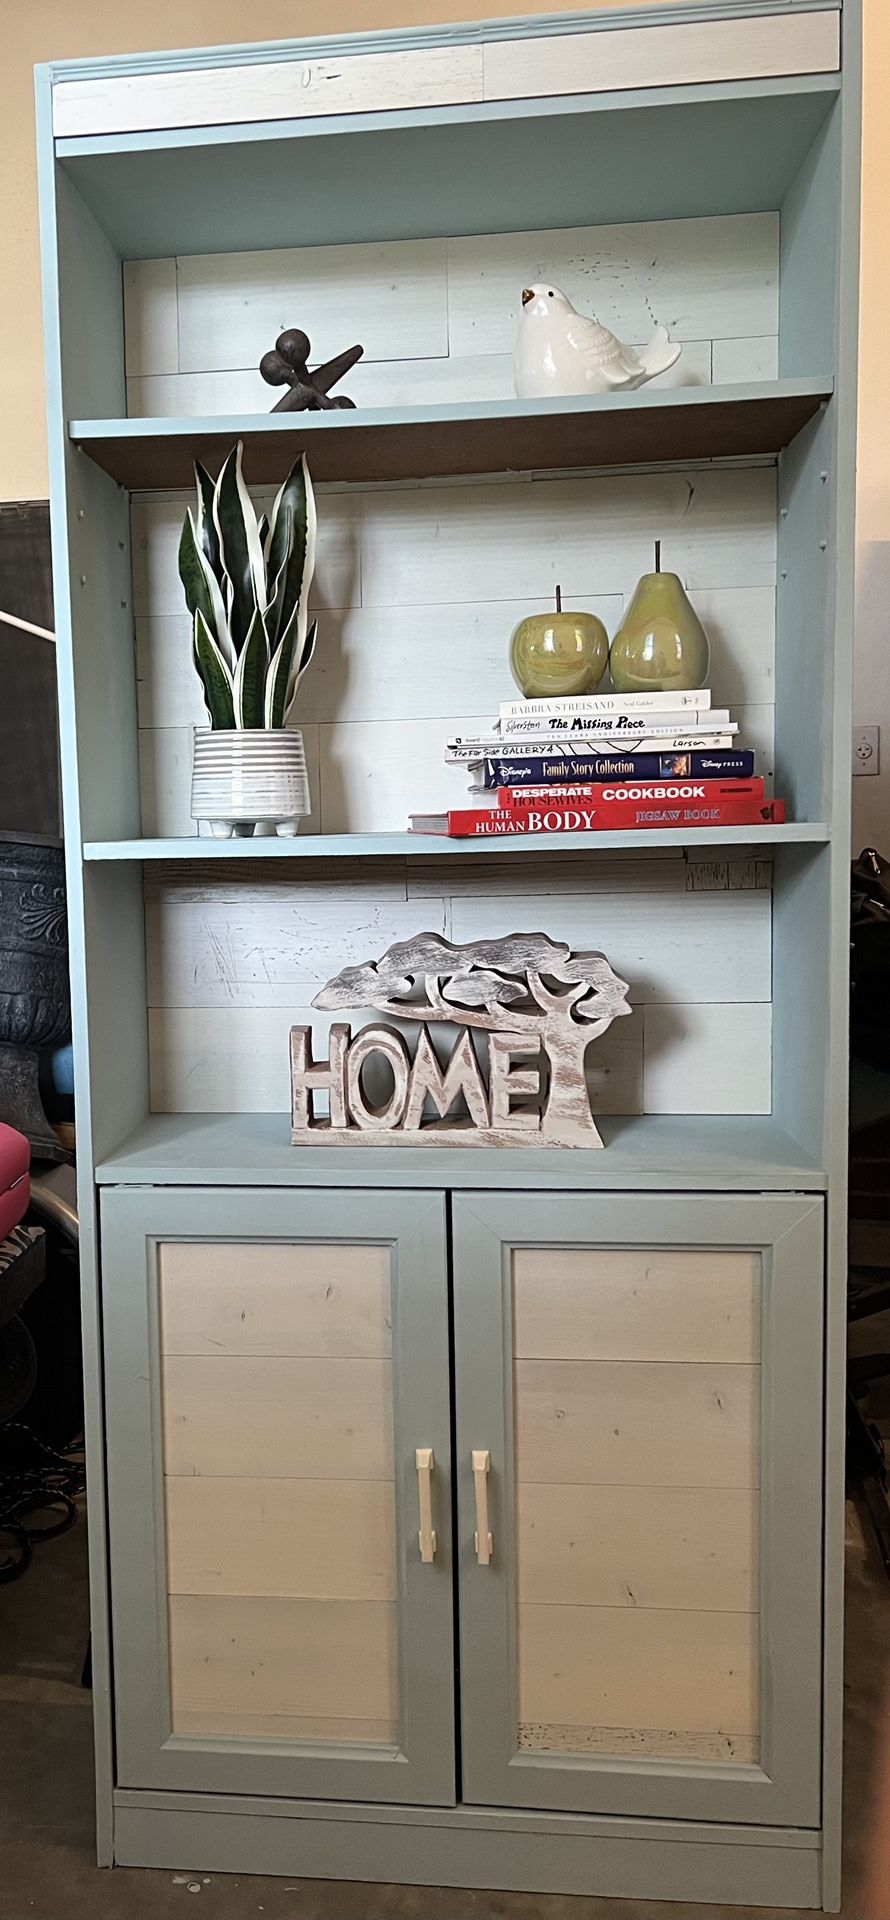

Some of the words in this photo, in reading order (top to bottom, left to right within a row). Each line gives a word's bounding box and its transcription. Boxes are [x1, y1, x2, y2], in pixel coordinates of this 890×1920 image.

[511, 704, 552, 715] BARBRA
[555, 700, 615, 712] STREISAND
[549, 718, 568, 729] The
[571, 717, 613, 730] Missing
[615, 716, 645, 729] Piece
[484, 748, 500, 756] Side
[502, 746, 546, 756] GALLERY
[546, 744, 553, 753] 4
[497, 766, 532, 777] Disney's
[542, 761, 569, 778] Family
[570, 760, 594, 778] Story
[595, 759, 635, 775] Collection
[700, 759, 722, 769] Disney
[511, 786, 593, 798] DESPERATE
[602, 786, 706, 801] COOKBOOK
[513, 795, 593, 807] HOUSEWIVES
[475, 821, 526, 833] HUMAN
[527, 810, 597, 831] BODY
[488, 810, 512, 820] THE
[635, 809, 682, 824] JIGSAW
[684, 808, 720, 820] BOOK
[289, 1022, 544, 1131] HOME
